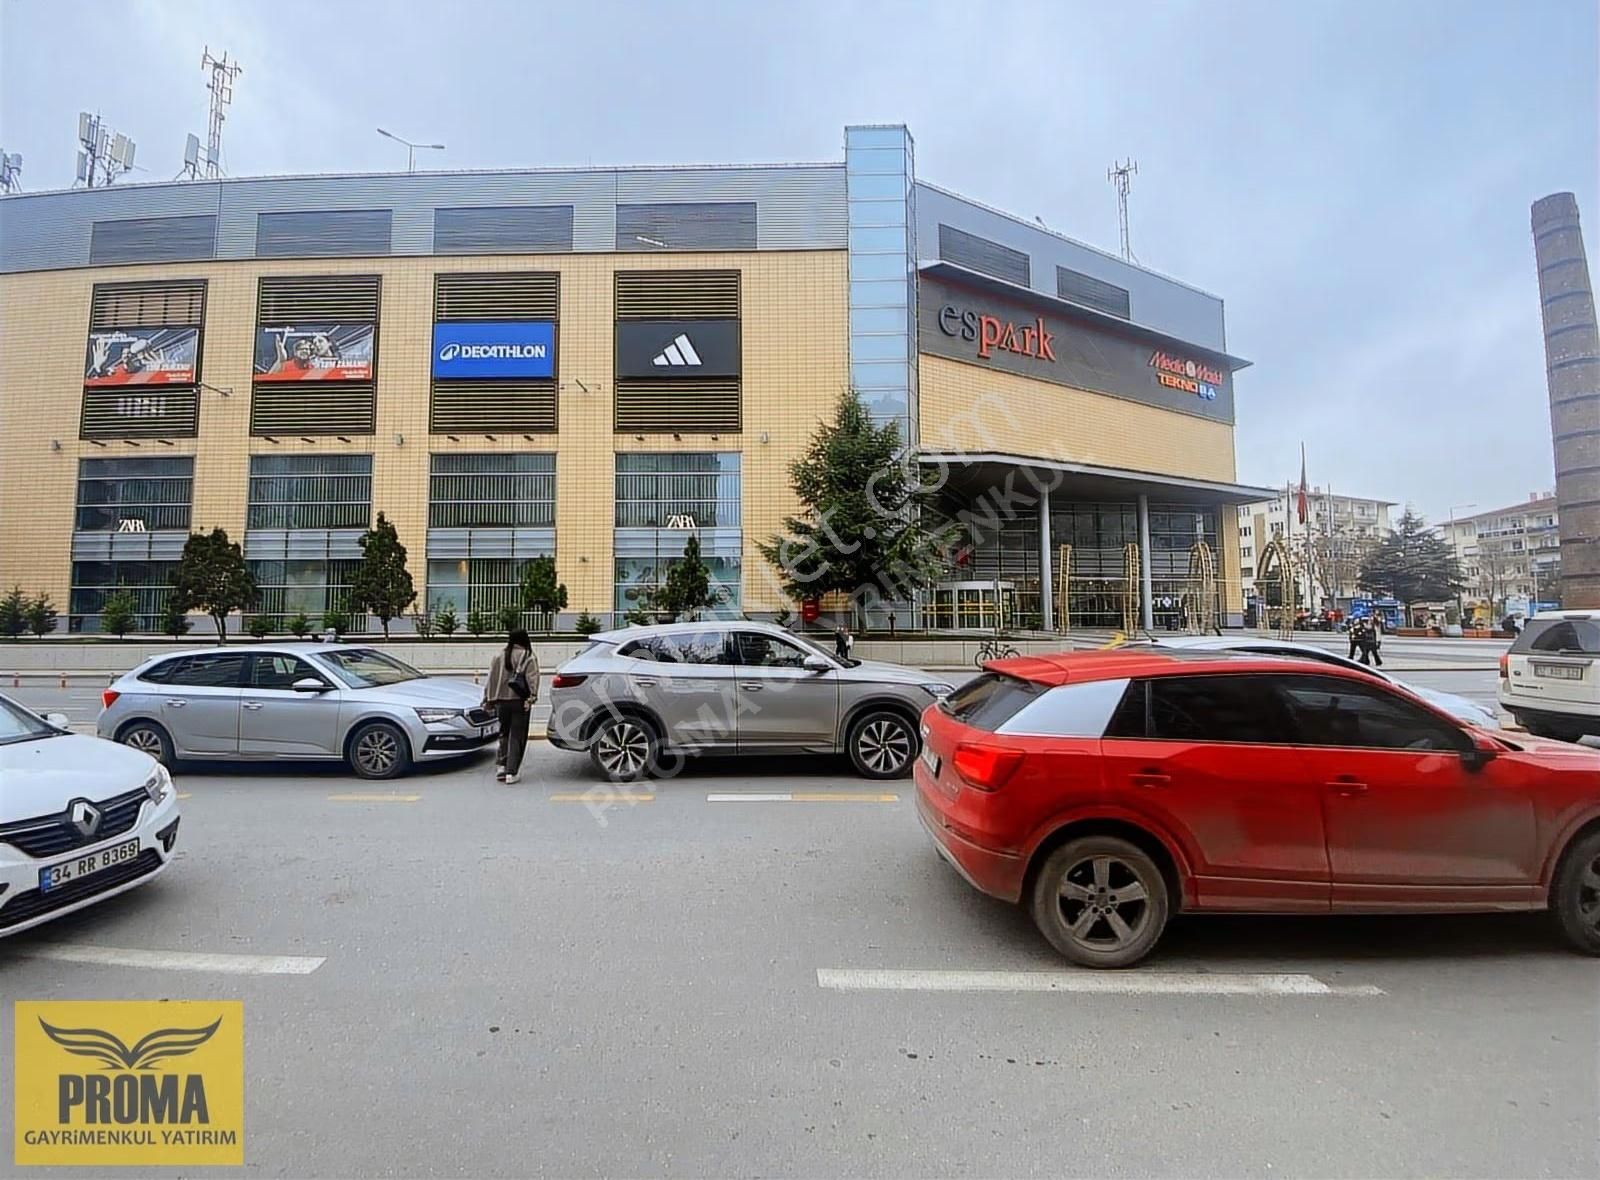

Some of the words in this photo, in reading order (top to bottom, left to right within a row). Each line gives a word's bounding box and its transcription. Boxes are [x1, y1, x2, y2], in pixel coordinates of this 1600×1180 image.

[461, 345, 546, 358] DECATHLON
[118, 519, 146, 533] ZARA
[666, 514, 697, 529] ZARA
[51, 865, 71, 884] 34
[78, 856, 97, 876] RR
[102, 842, 137, 866] 8369
